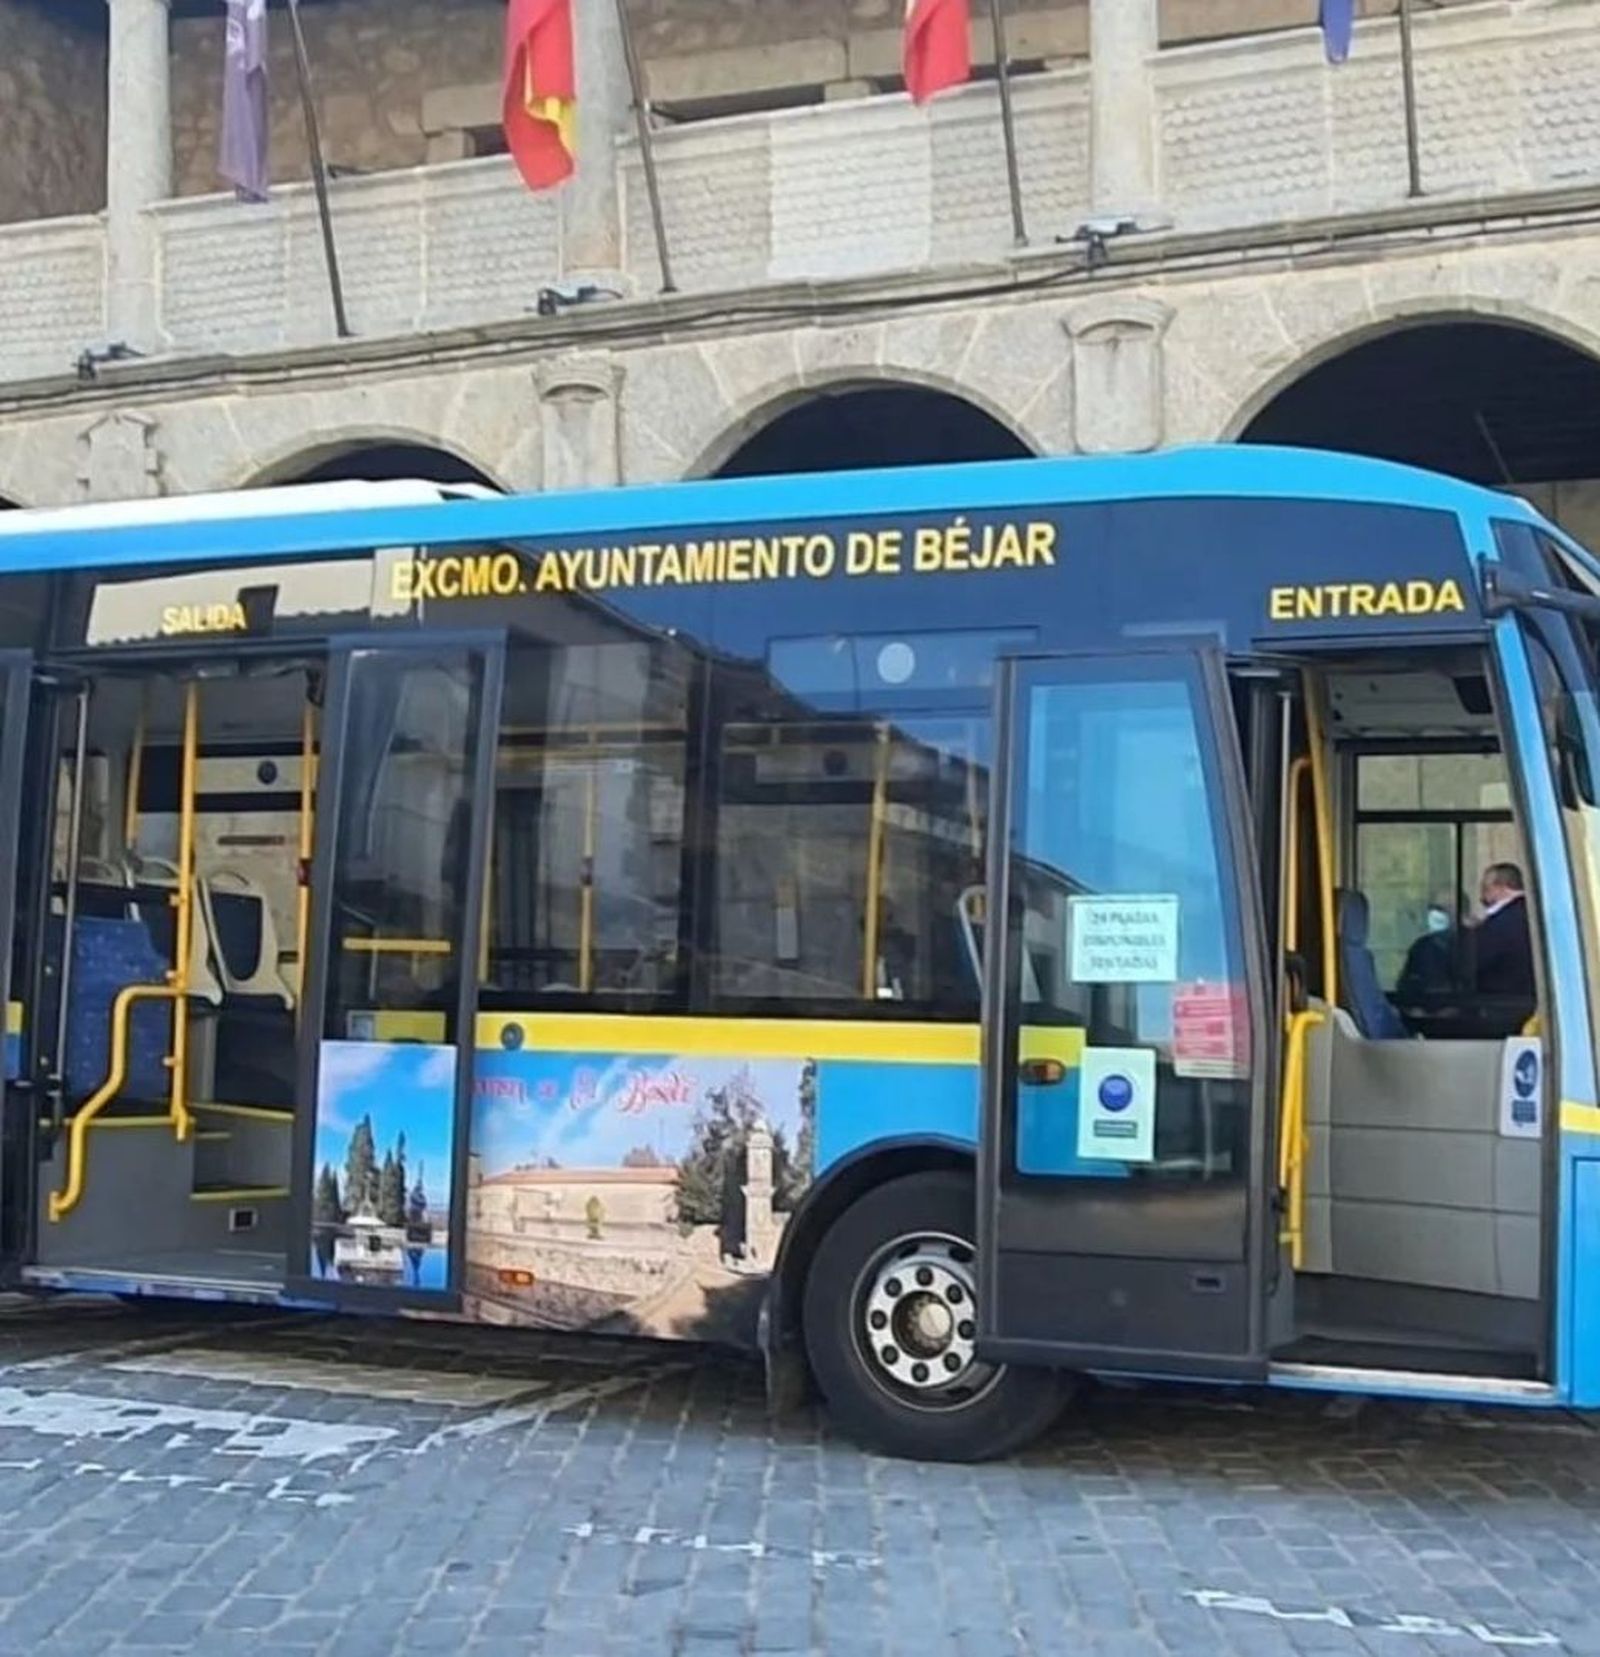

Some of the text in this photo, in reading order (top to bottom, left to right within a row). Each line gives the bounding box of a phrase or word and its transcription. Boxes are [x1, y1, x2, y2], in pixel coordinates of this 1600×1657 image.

[391, 517, 1057, 600] EXCMO. AYUNTAMIENTO DE BÉJAR
[161, 602, 247, 634] SALIDA
[1270, 579, 1465, 619] ENTRADA
